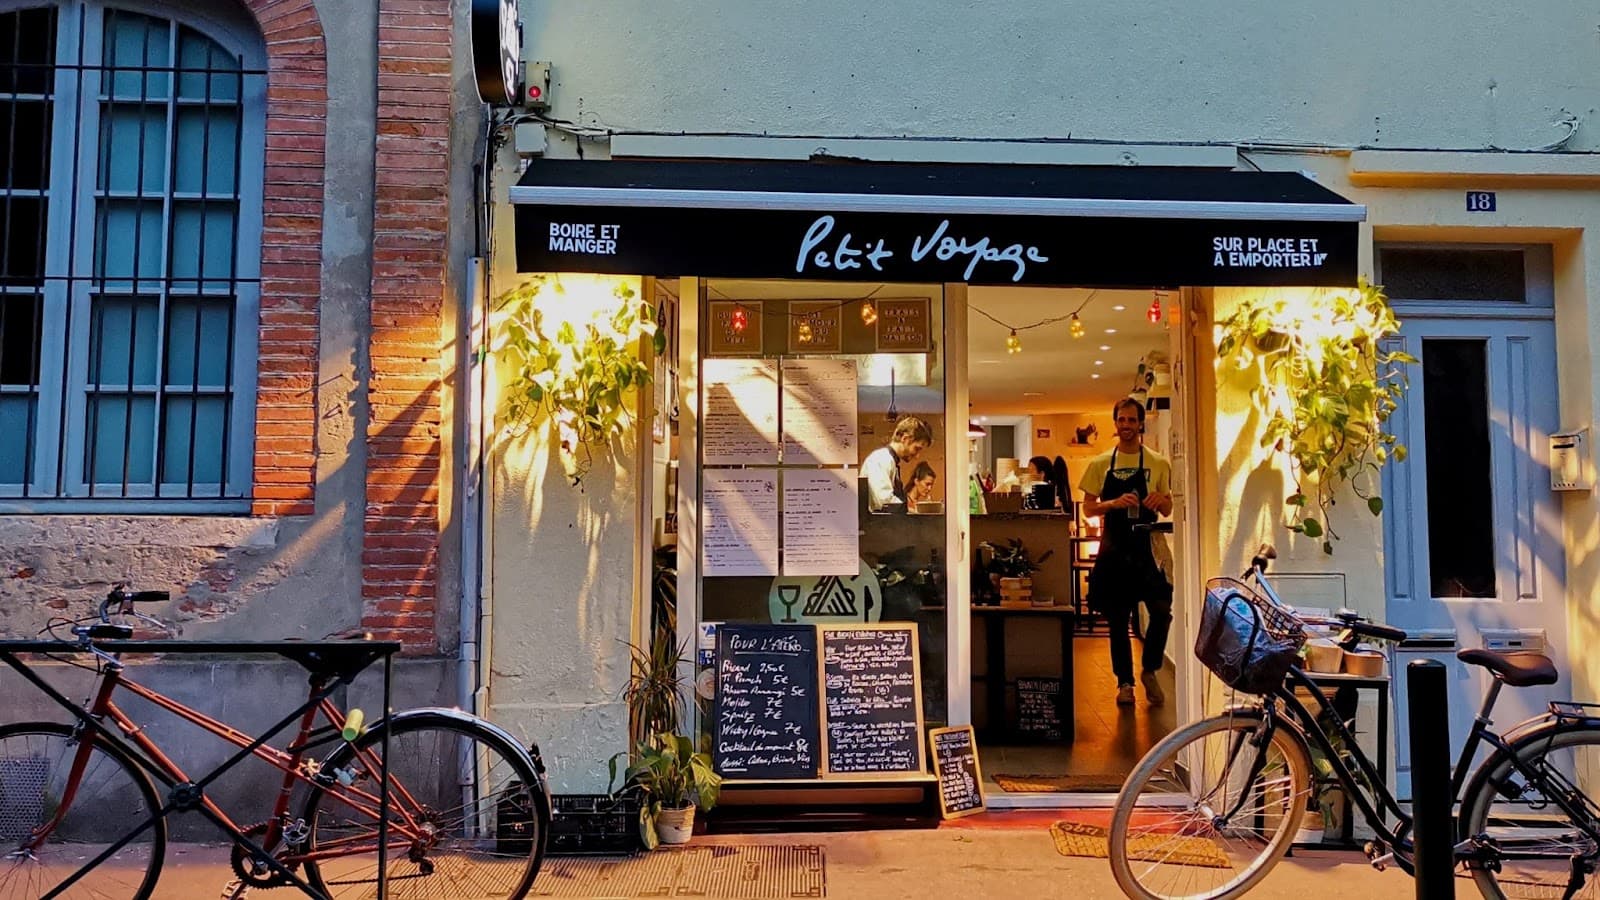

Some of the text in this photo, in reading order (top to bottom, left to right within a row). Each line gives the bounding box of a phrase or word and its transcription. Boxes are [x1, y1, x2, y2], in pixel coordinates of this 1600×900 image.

[1470, 193, 1491, 209] 18
[550, 223, 620, 239] BOIRE ET
[549, 239, 616, 254] MANGER
[796, 214, 1048, 282] Petit Voyage
[1213, 237, 1318, 252] SUR PLACE ET
[1214, 252, 1311, 267] A EMPORTER
[730, 634, 757, 649] POUR
[722, 659, 751, 673] Ricard
[735, 672, 762, 684] Punch
[772, 674, 789, 685] 5€
[790, 685, 806, 696] 5€
[721, 696, 783, 711] Mojito 7€
[721, 707, 782, 723] Spritz 7€
[784, 722, 802, 735] 7€
[719, 740, 756, 753] Cocktail
[764, 742, 796, 751] moment
[796, 738, 809, 753] 8€
